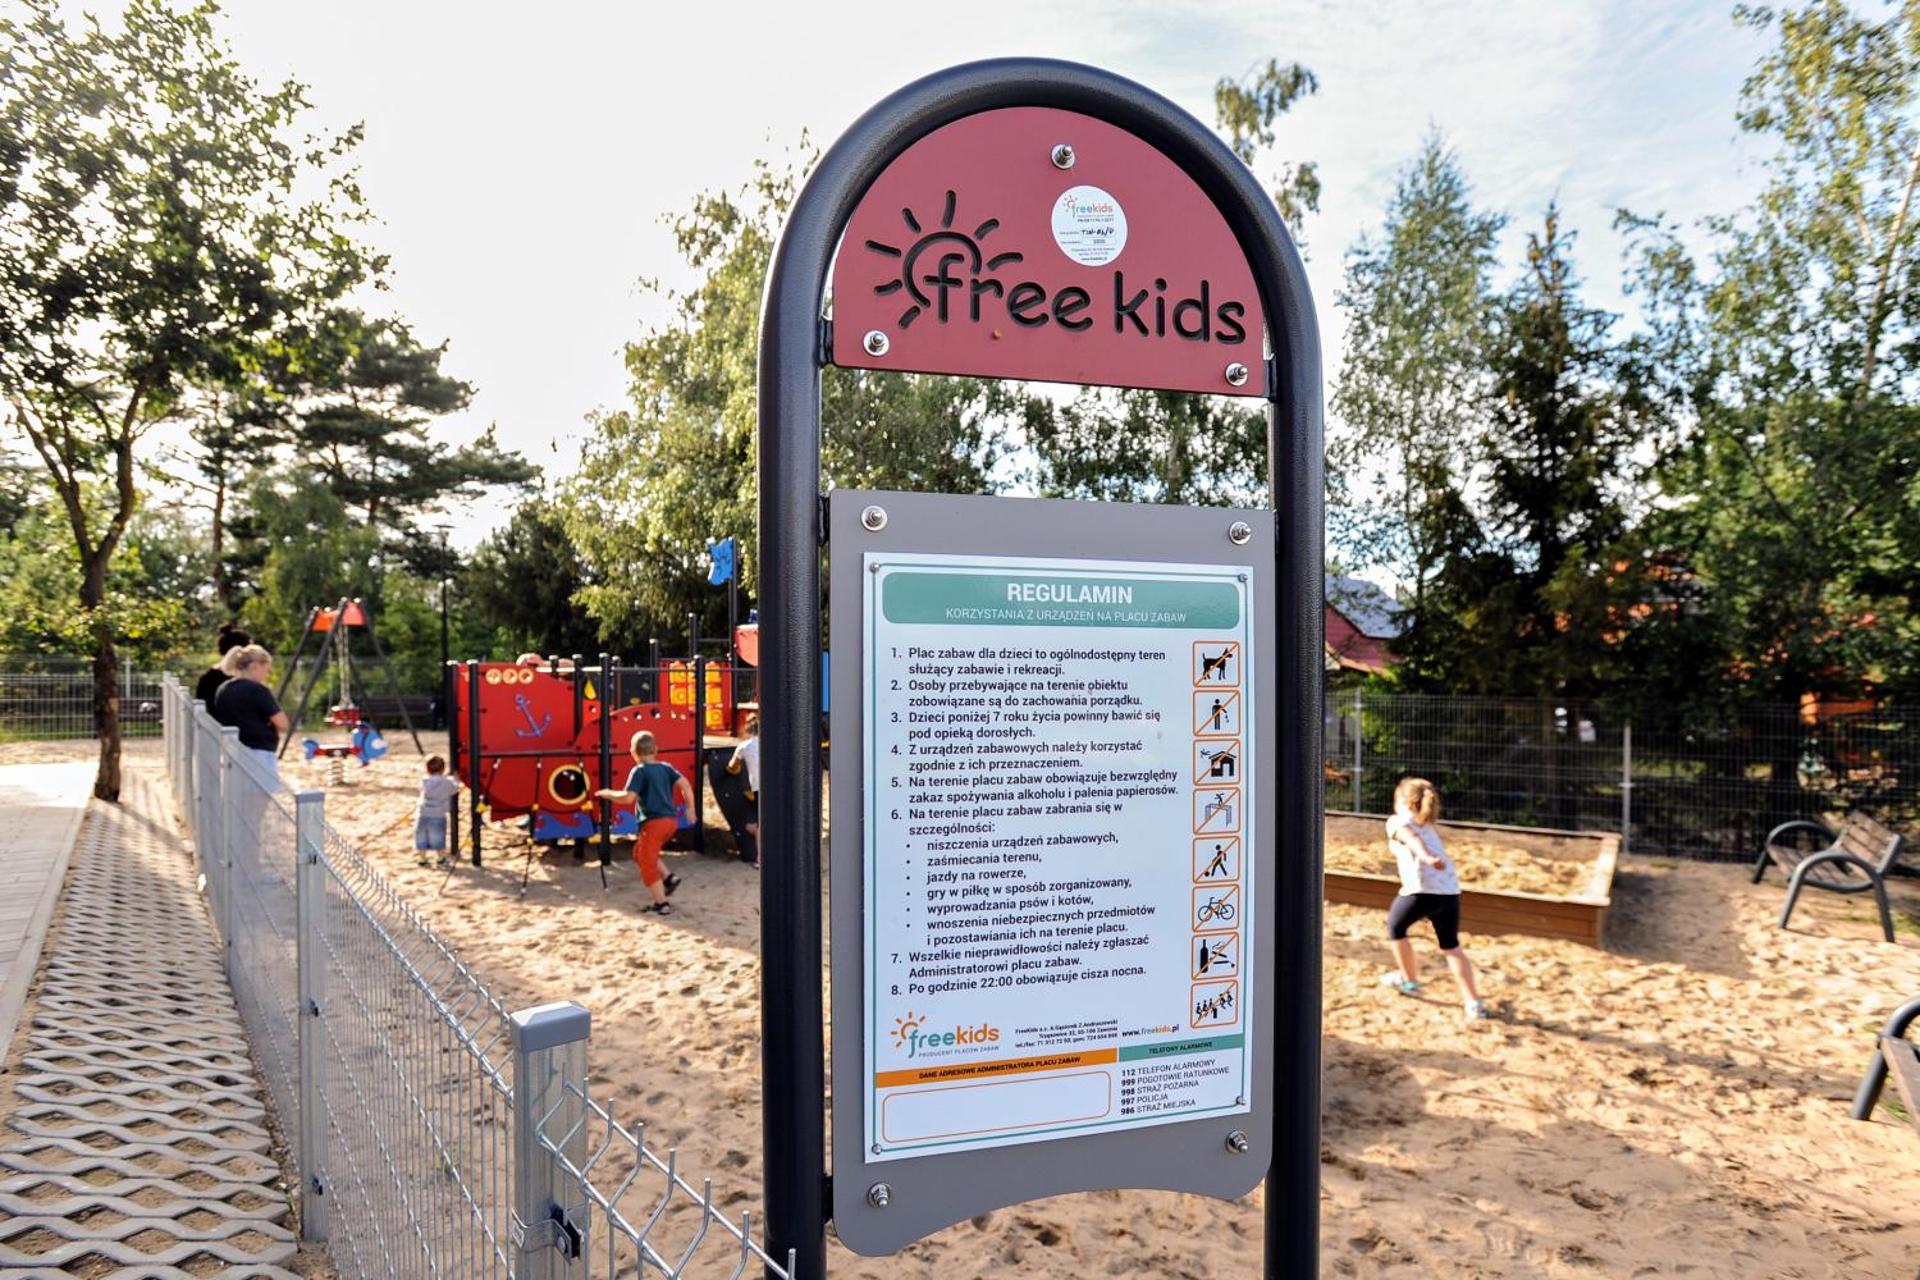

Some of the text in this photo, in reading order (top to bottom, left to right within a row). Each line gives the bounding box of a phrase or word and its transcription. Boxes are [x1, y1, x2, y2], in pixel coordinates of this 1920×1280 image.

[923, 253, 1247, 344] free kids
[1007, 583, 1133, 604] REGULAMIN
[946, 608, 1186, 623] KORZYSTANIA Z URZĄDZEŃ NA PLACU ZABAW
[891, 647, 1166, 662] 1. Plac zabaw dla dzieci to ogólnodostępny teren
[908, 663, 954, 677] służący
[957, 663, 1004, 674] zabawie
[1014, 663, 1065, 677] rekreacji.
[890, 678, 1128, 693] 2. Osoby przebywające na terenie obiektu
[908, 694, 1143, 708] zobowiązane są do zachowania porządku.
[890, 709, 1161, 724] 3. Dzieci poniżej 7 roku życia powinny bawić się
[908, 726, 1036, 741] pod opieką dorosłych.
[890, 740, 1143, 756] 4. Z urządzeń zabawowych należy korzystać
[908, 757, 1083, 773] zgodnie z ich przeznaczeniem.
[891, 770, 1178, 787] 5. Na terenie placu zabaw obowiązuje bezwzględny
[908, 791, 943, 803] zakaz
[946, 790, 1014, 804] spożywania
[1017, 788, 1066, 800] alkoholu
[1074, 787, 1113, 801] palenia
[1116, 785, 1178, 799] papierosów.
[891, 802, 1123, 819] 6. Na terenie placu zabaw zabrania się w
[909, 822, 996, 836] szczególności:
[927, 832, 1119, 849] niszczenia urządzeń zabawowych,
[927, 853, 1042, 865] zaśmiecania terenu,
[926, 870, 1027, 884] jazdy na rowerze,
[927, 880, 1132, 901] gry w piłkę w sposób zorganizowany,
[927, 899, 1017, 915] wyprowadzania
[1019, 897, 1048, 911] psów
[1058, 895, 1095, 907] kotów,
[927, 905, 1156, 929] wnoszenia niebezpiecznych przedmiotów
[934, 929, 1017, 947] pozostawiania
[1020, 927, 1037, 938] ich
[1038, 929, 1053, 937] na
[1055, 924, 1094, 936] terenie
[1096, 922, 1129, 936] placu.
[890, 935, 1149, 963] 7. Wszelkie nieprawidłowości należy zgłaszać
[908, 956, 1082, 977] Administratorowi placu zabaw.
[890, 967, 1147, 994] 8. Po godzinie 22:00 obowiązuje cisza nocna.
[908, 1023, 1000, 1058] freekids
[1035, 1059, 1057, 1068] PLACU
[1058, 1057, 1081, 1065] ZABAW
[1138, 1066, 1171, 1075] TELEFON
[1172, 1060, 1216, 1070] ALARMOWY
[1137, 1073, 1182, 1085] POGOTOWIE
[1183, 1066, 1229, 1079] RATUNKOWE
[1137, 1083, 1161, 1094] STRAŻ
[1137, 1093, 1168, 1103] POLICJA
[1121, 1099, 1196, 1115] 986 STRAŻ MIEJSKA
